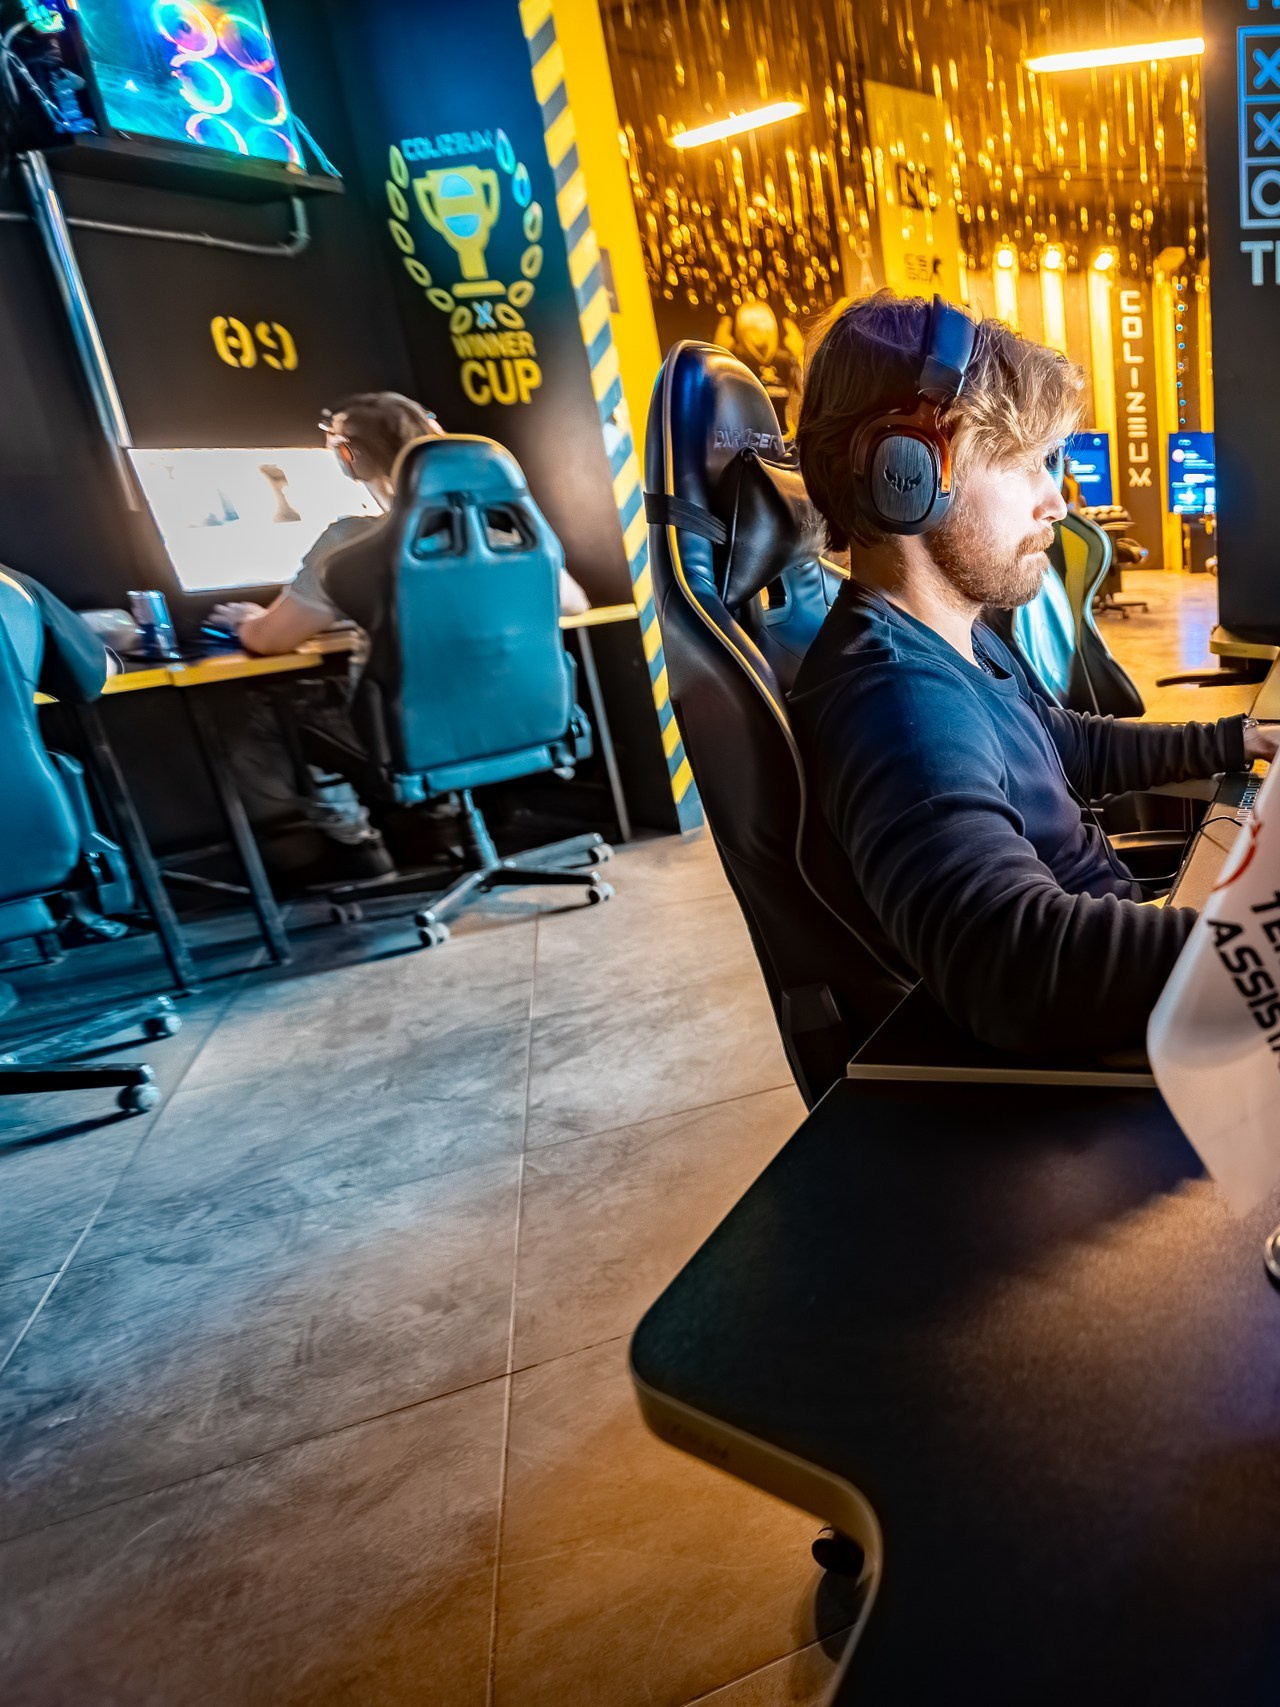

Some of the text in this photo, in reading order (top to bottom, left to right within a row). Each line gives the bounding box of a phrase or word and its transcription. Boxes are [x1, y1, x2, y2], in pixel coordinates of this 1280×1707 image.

[210, 315, 299, 371] 09
[451, 330, 537, 360] WINNER
[460, 358, 543, 406] CUP
[1119, 290, 1152, 488] COLIZEUM
